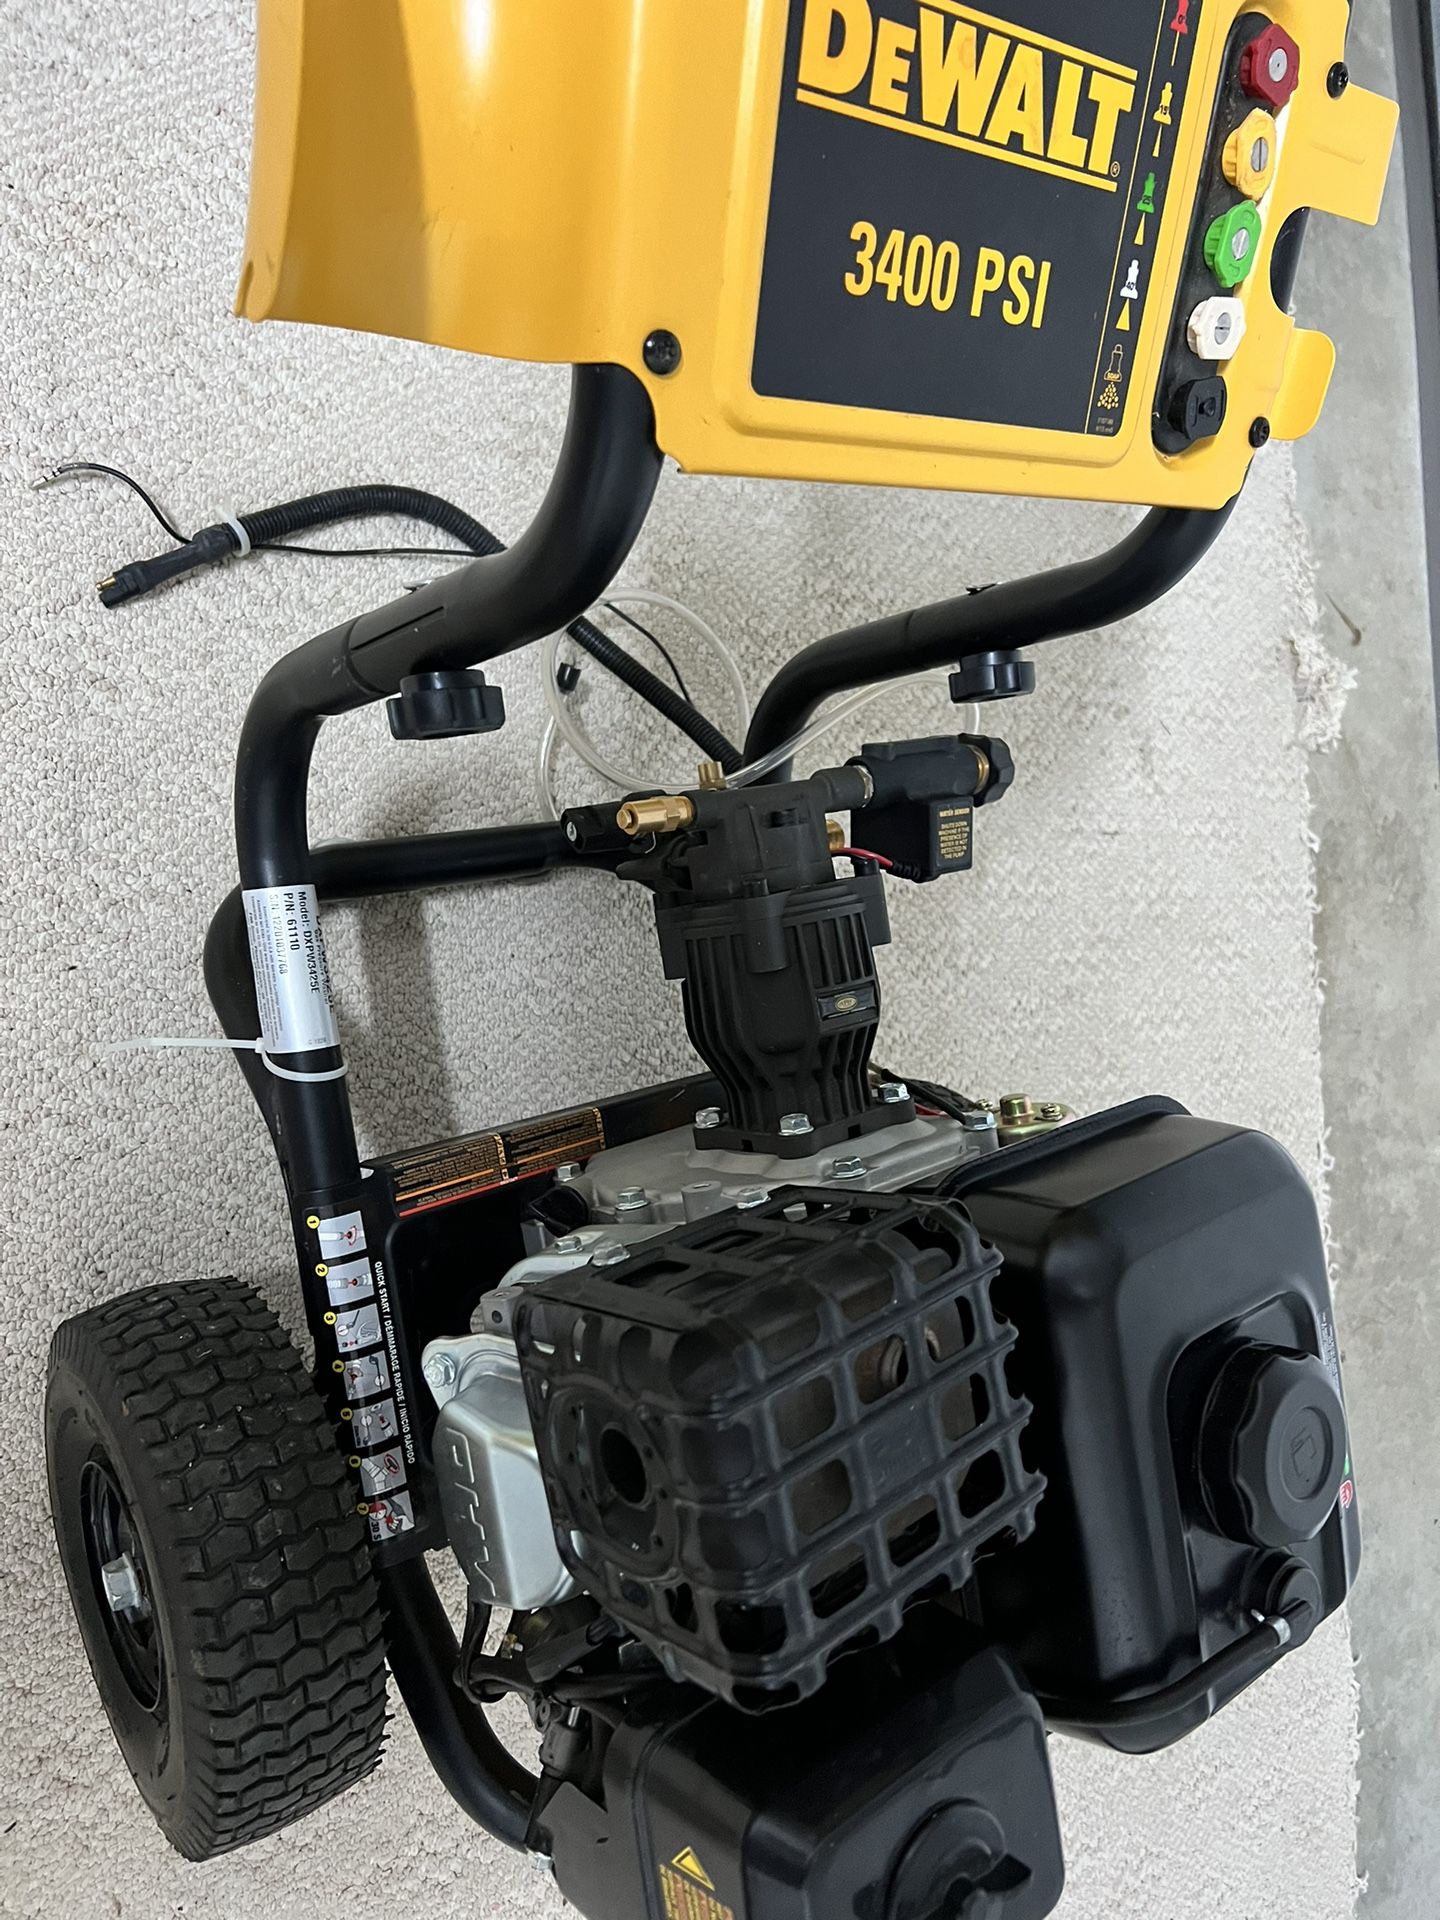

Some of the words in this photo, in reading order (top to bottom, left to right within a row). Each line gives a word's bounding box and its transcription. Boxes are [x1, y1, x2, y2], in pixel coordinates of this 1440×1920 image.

[844, 221, 960, 312] 3400
[970, 246, 1052, 328] PSI
[284, 892, 296, 916] P/N:
[298, 891, 311, 927] Model:
[286, 918, 300, 951] 61110
[303, 930, 320, 994] DXPW3425E
[374, 1261, 386, 1287] QUICK
[379, 1288, 390, 1313] START
[393, 1372, 405, 1402] RAPIDE
[400, 1408, 410, 1433] INICIO
